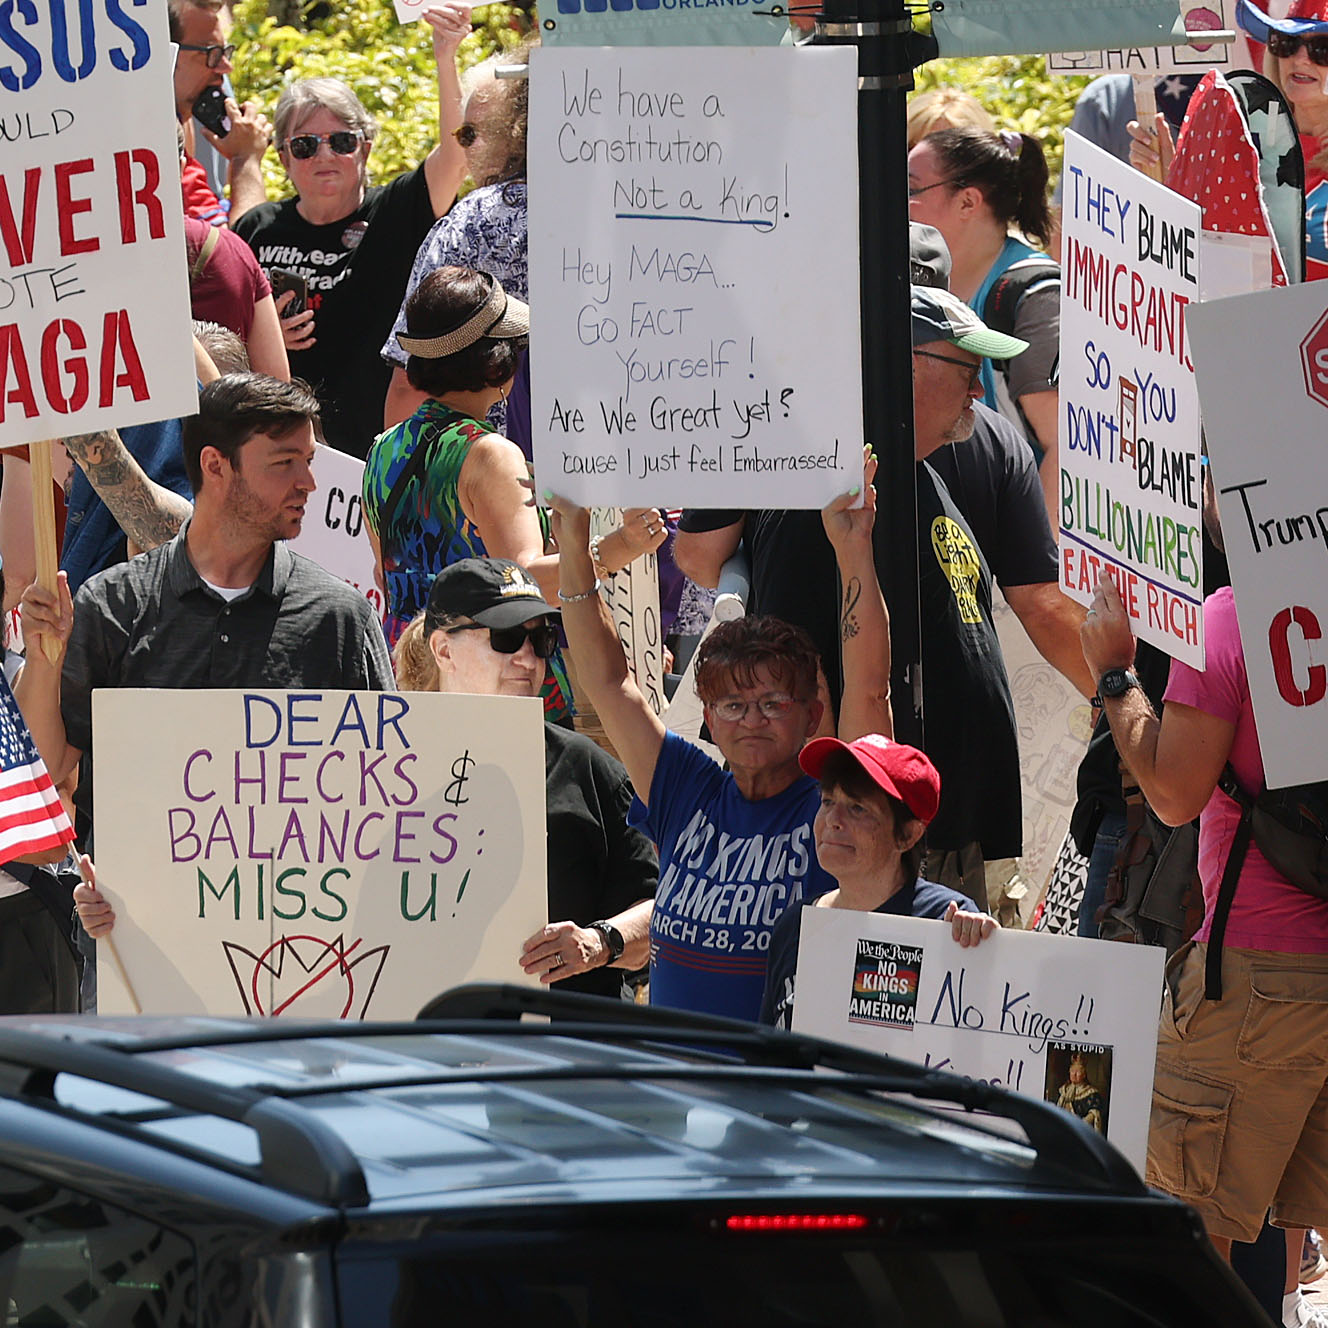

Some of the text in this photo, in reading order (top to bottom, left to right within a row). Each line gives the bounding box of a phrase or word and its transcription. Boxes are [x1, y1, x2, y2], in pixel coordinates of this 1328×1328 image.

[1069, 164, 1197, 284] THEY BLAME
[1084, 341, 1177, 423] SO YOU
[1067, 400, 1198, 510] DON'T BLAME
[1062, 469, 1199, 589] BILLIONAIRES
[1147, 583, 1199, 646] RICH
[243, 694, 409, 750] DEAR
[183, 749, 475, 807] CHECKS &
[197, 864, 351, 922] MISS
[856, 942, 922, 965] We the People
[877, 960, 897, 976] NO
[850, 998, 915, 1020] AMERICA
[862, 976, 908, 995] KINGS
[879, 992, 889, 1002] IN
[930, 968, 984, 1031] No
